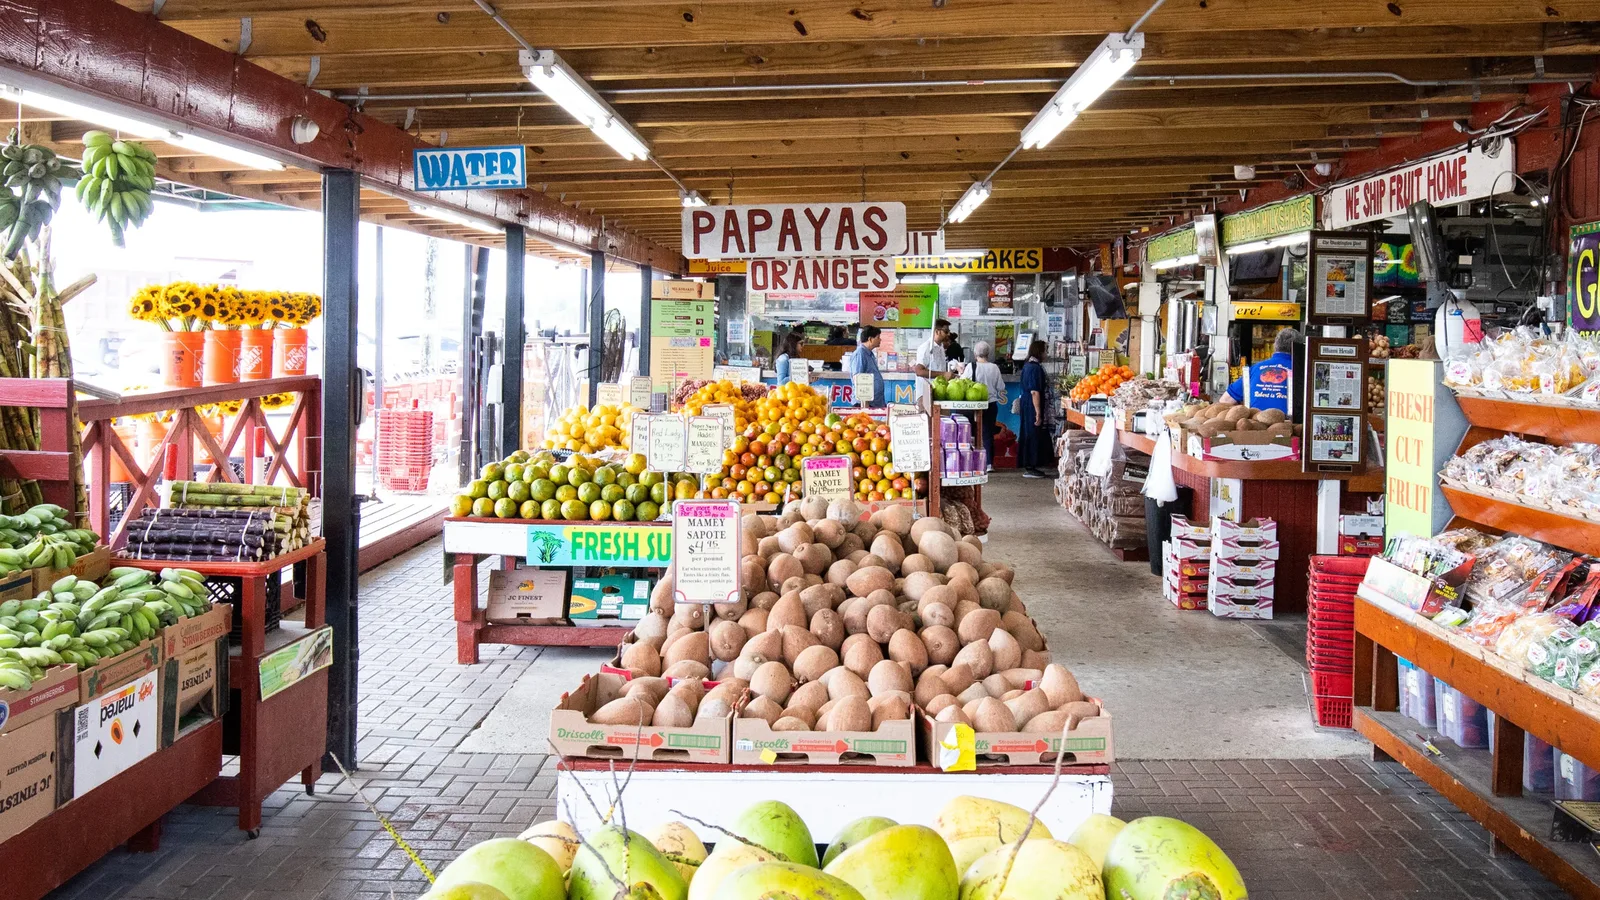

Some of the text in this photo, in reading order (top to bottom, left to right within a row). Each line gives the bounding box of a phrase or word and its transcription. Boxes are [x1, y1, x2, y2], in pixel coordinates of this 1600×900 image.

[419, 152, 518, 187] WATER
[1345, 155, 1467, 221] WE SHIP FRUIT HOME
[1262, 199, 1312, 234] MILKSHAKES
[692, 206, 888, 254] PAPAYAS
[706, 264, 731, 272] Juice
[751, 258, 889, 290] ORANGES
[1237, 306, 1263, 316] ere!
[1389, 390, 1433, 424] FRESH
[1395, 435, 1423, 468] CUT
[813, 470, 840, 478] MAMEY
[813, 479, 842, 487] SAPOTE
[1389, 477, 1429, 514] FRUIT
[687, 518, 725, 527] MAMEY
[687, 531, 726, 539] SAPOTE
[571, 531, 672, 562] FRESH SU
[182, 623, 223, 648] STRAWBERRIES
[182, 668, 212, 691] JC FINEST
[30, 684, 65, 706] STRAWBERRIES
[557, 728, 604, 740] Driscoll's
[742, 738, 789, 749] iscoll's
[6, 760, 27, 776] QUALITY
[40, 774, 51, 793] JC
